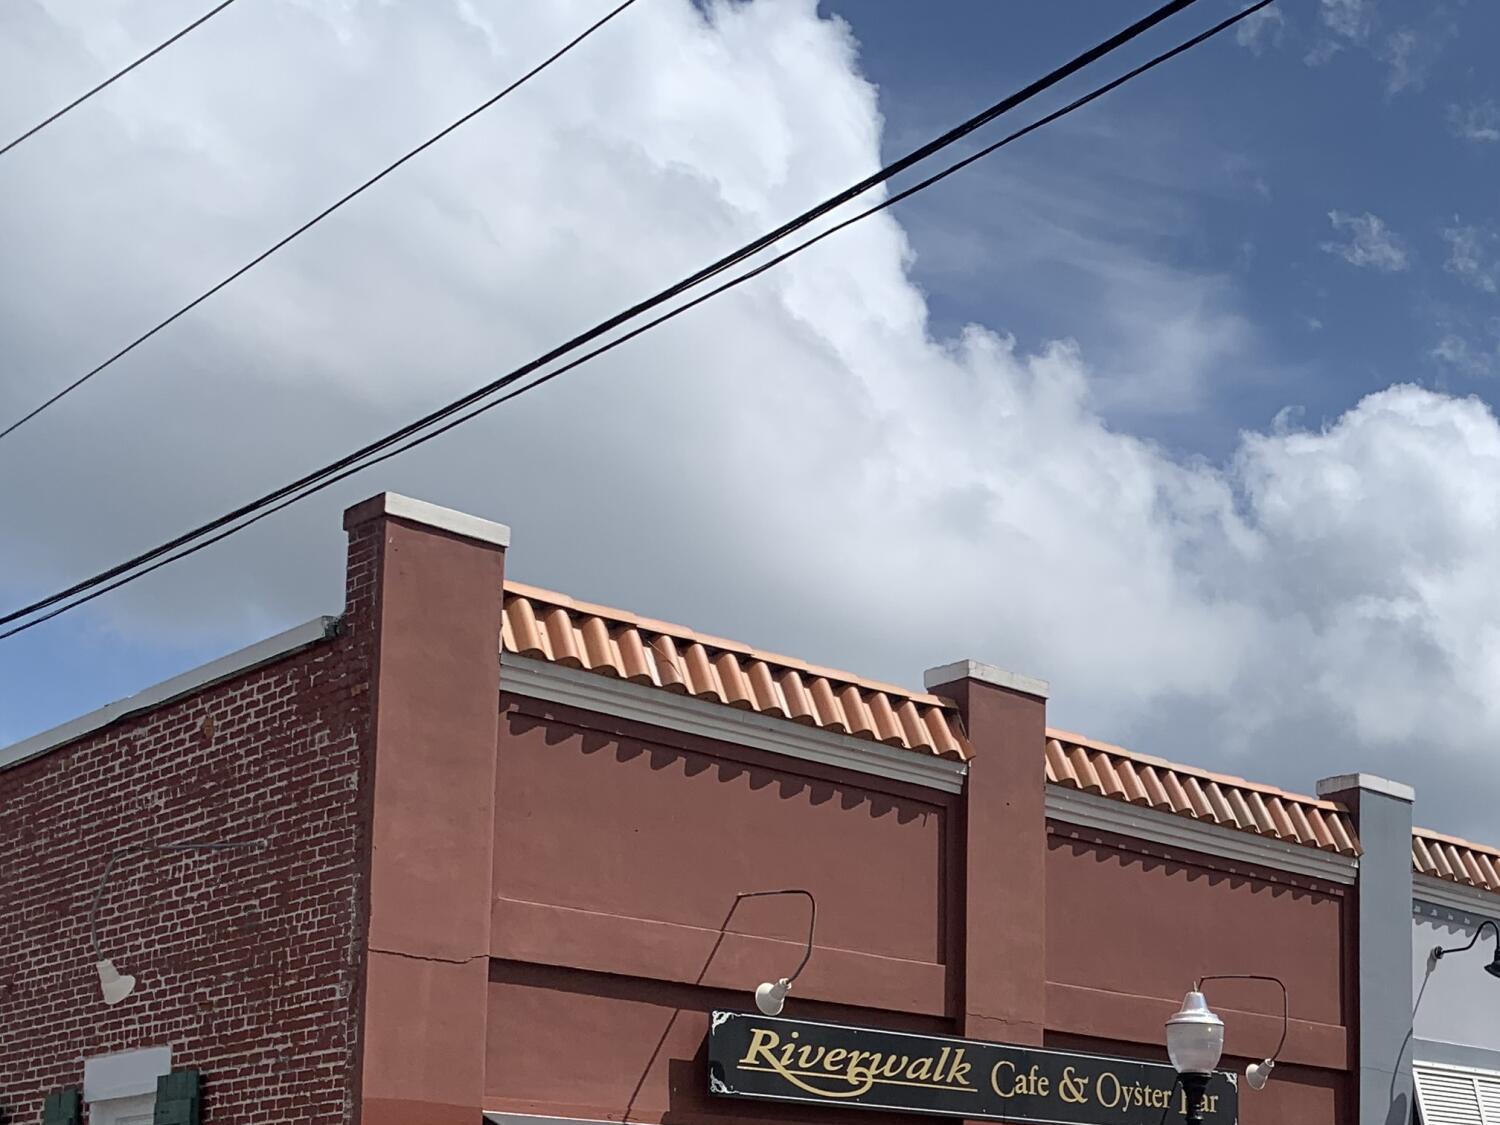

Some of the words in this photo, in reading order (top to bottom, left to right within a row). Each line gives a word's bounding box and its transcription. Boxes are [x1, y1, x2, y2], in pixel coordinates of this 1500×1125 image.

[738, 1028, 978, 1097] Riverwalk
[991, 1060, 1050, 1098] Cafe
[1058, 1066, 1089, 1104] &
[1096, 1072, 1172, 1112] Oyster
